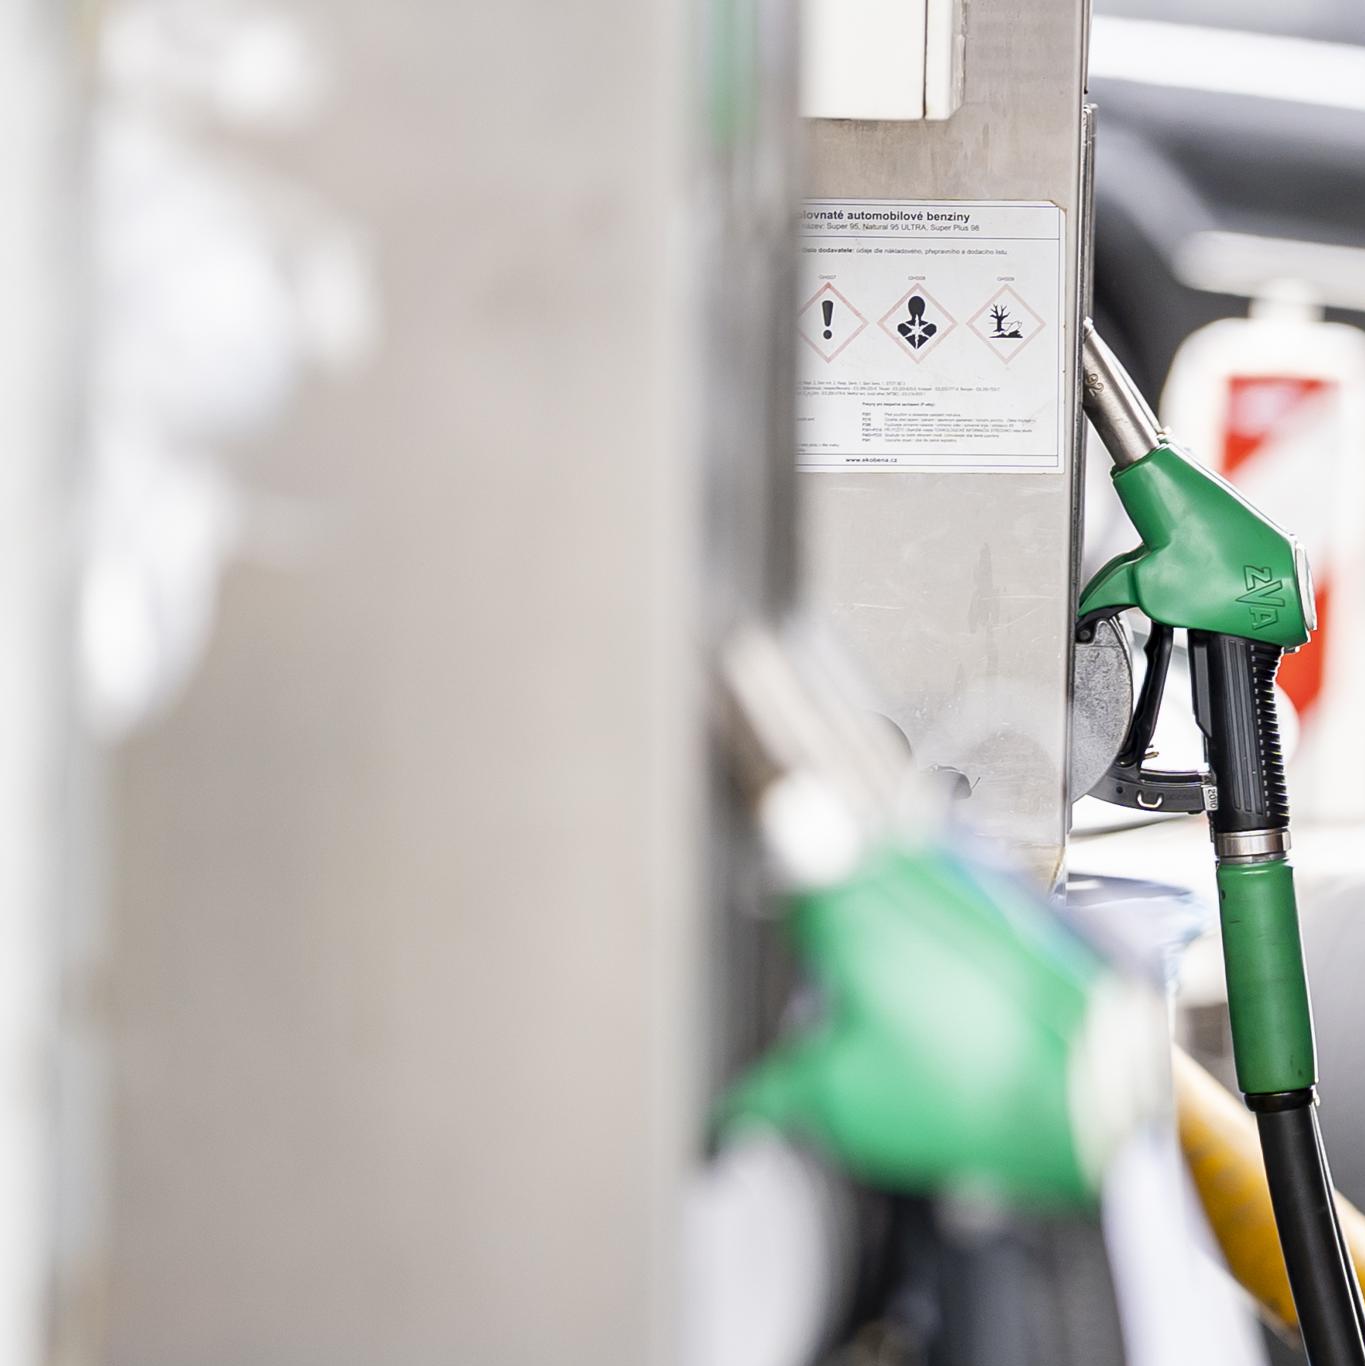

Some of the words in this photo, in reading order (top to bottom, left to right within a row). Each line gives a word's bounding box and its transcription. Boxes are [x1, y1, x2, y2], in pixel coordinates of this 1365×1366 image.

[847, 210, 923, 221] automobilové
[926, 212, 971, 223] benziny
[826, 222, 848, 231] Super
[929, 224, 952, 232] Super
[953, 224, 969, 232] Plus
[1235, 564, 1286, 631] ZVA
